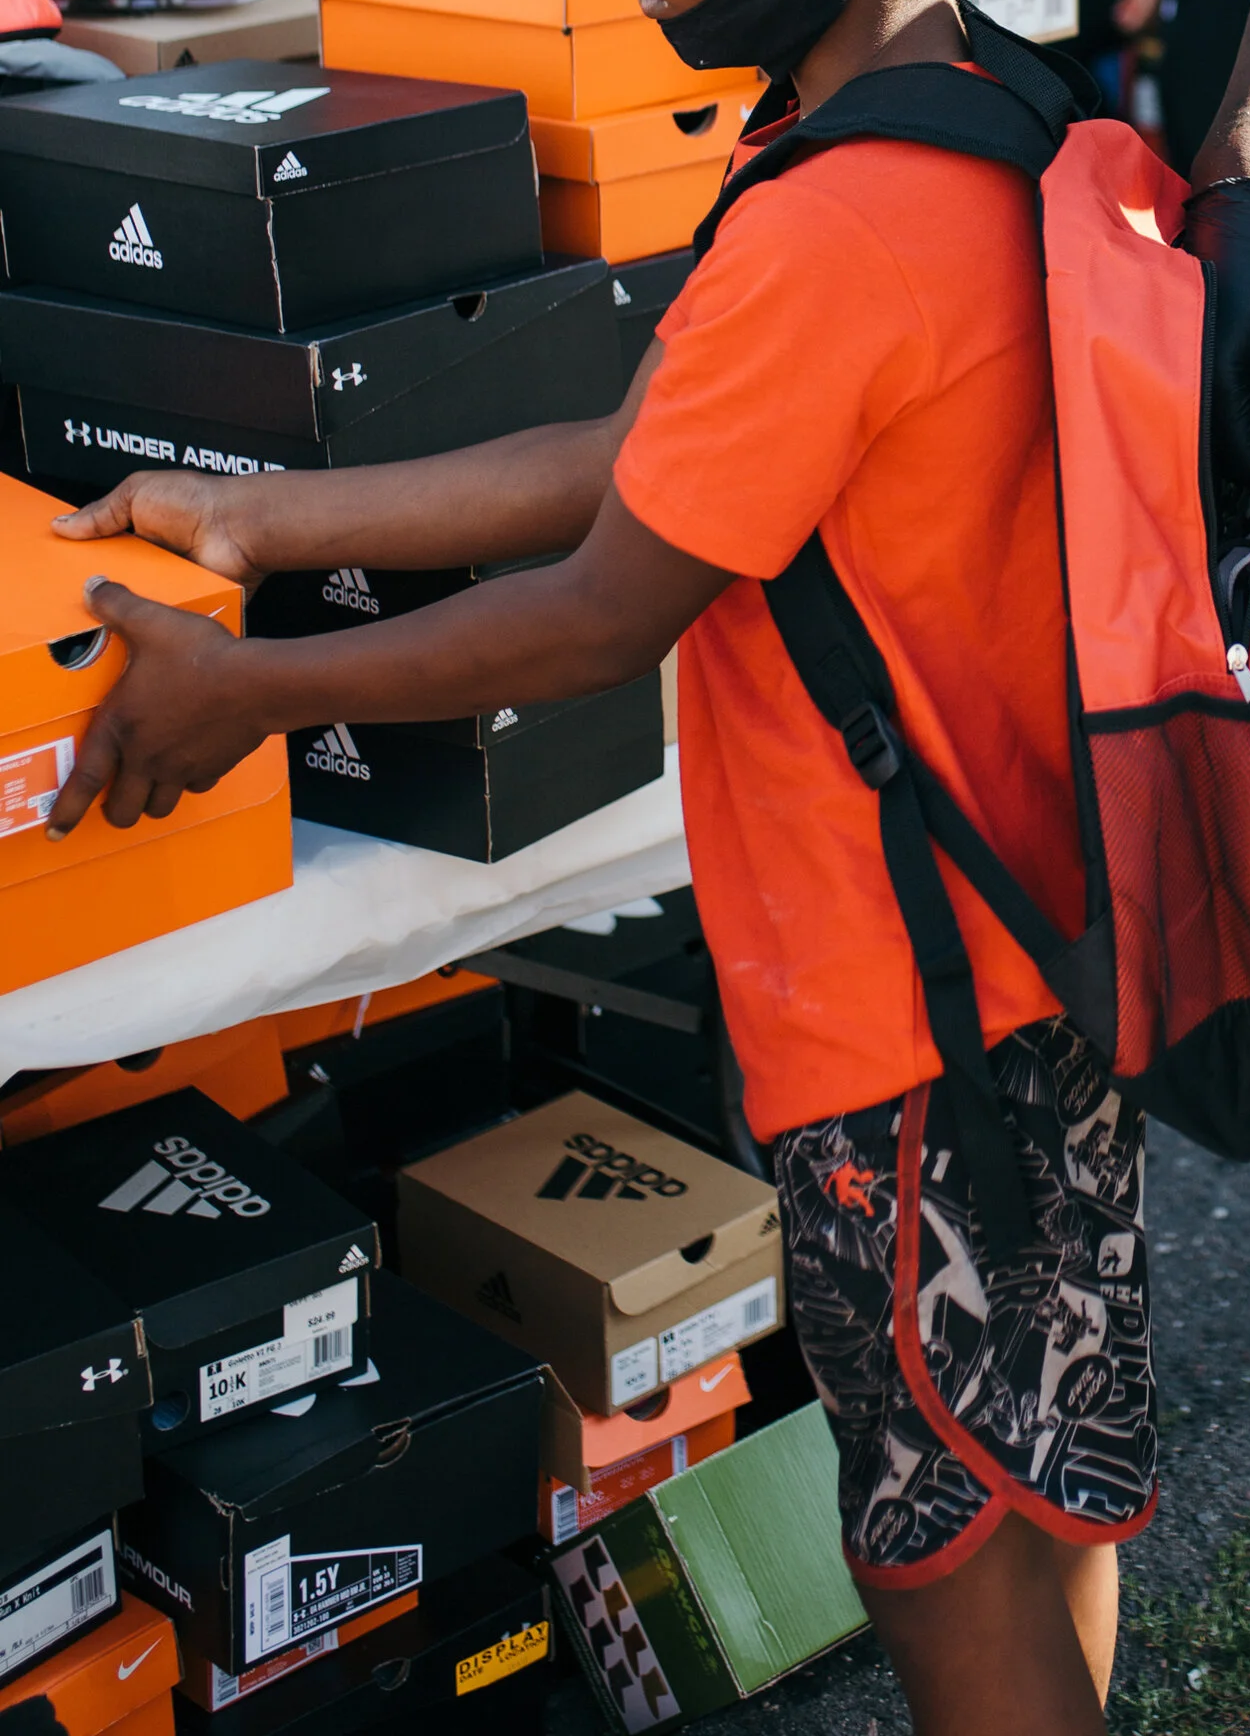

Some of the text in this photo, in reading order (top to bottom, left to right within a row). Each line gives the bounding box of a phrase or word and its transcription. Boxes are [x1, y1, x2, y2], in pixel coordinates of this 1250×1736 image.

[273, 166, 308, 182] adidas
[108, 240, 163, 270] adidas
[96, 426, 175, 462] UNDER
[322, 583, 380, 614] adidas
[492, 714, 518, 732] adidas
[305, 750, 371, 781] adidas
[153, 1135, 271, 1217] adidas
[563, 1132, 688, 1197] adidas
[299, 1563, 340, 1603] 1.5Y
[459, 1625, 545, 1675] DISPLAY
